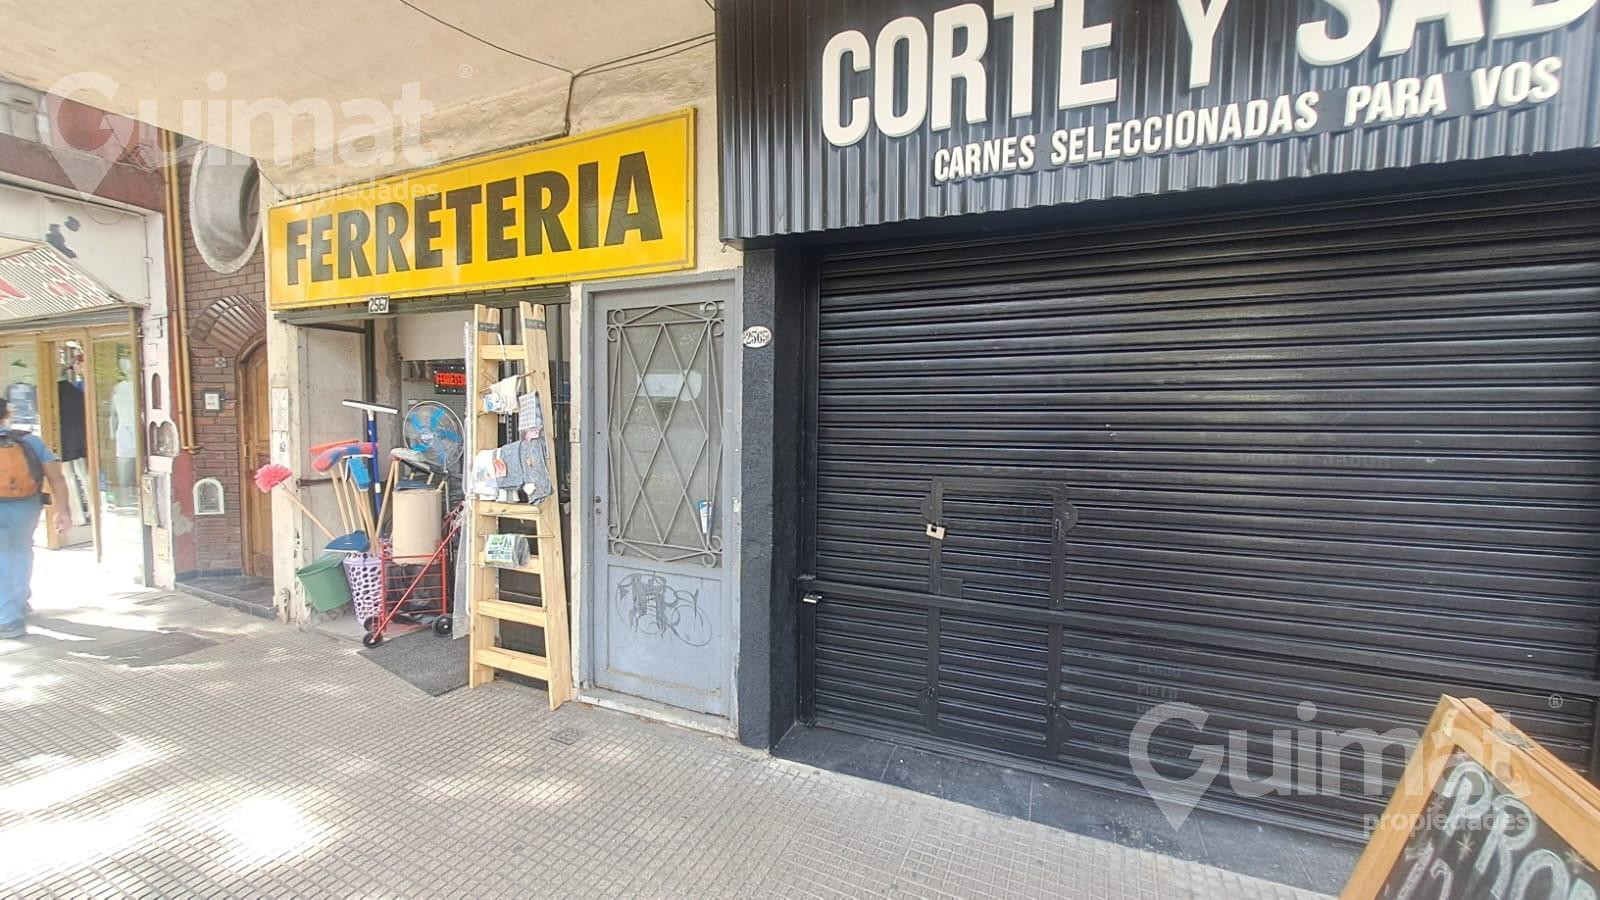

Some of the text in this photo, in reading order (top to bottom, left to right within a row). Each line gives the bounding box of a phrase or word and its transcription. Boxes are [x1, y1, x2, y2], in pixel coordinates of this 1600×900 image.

[822, 0, 1117, 146] CORTE
[1178, 0, 1228, 88] Y
[934, 56, 1562, 182] CARNES SELECCIONADAS PARA VOS
[286, 152, 663, 285] FERRETERIA
[369, 297, 388, 312] 2567
